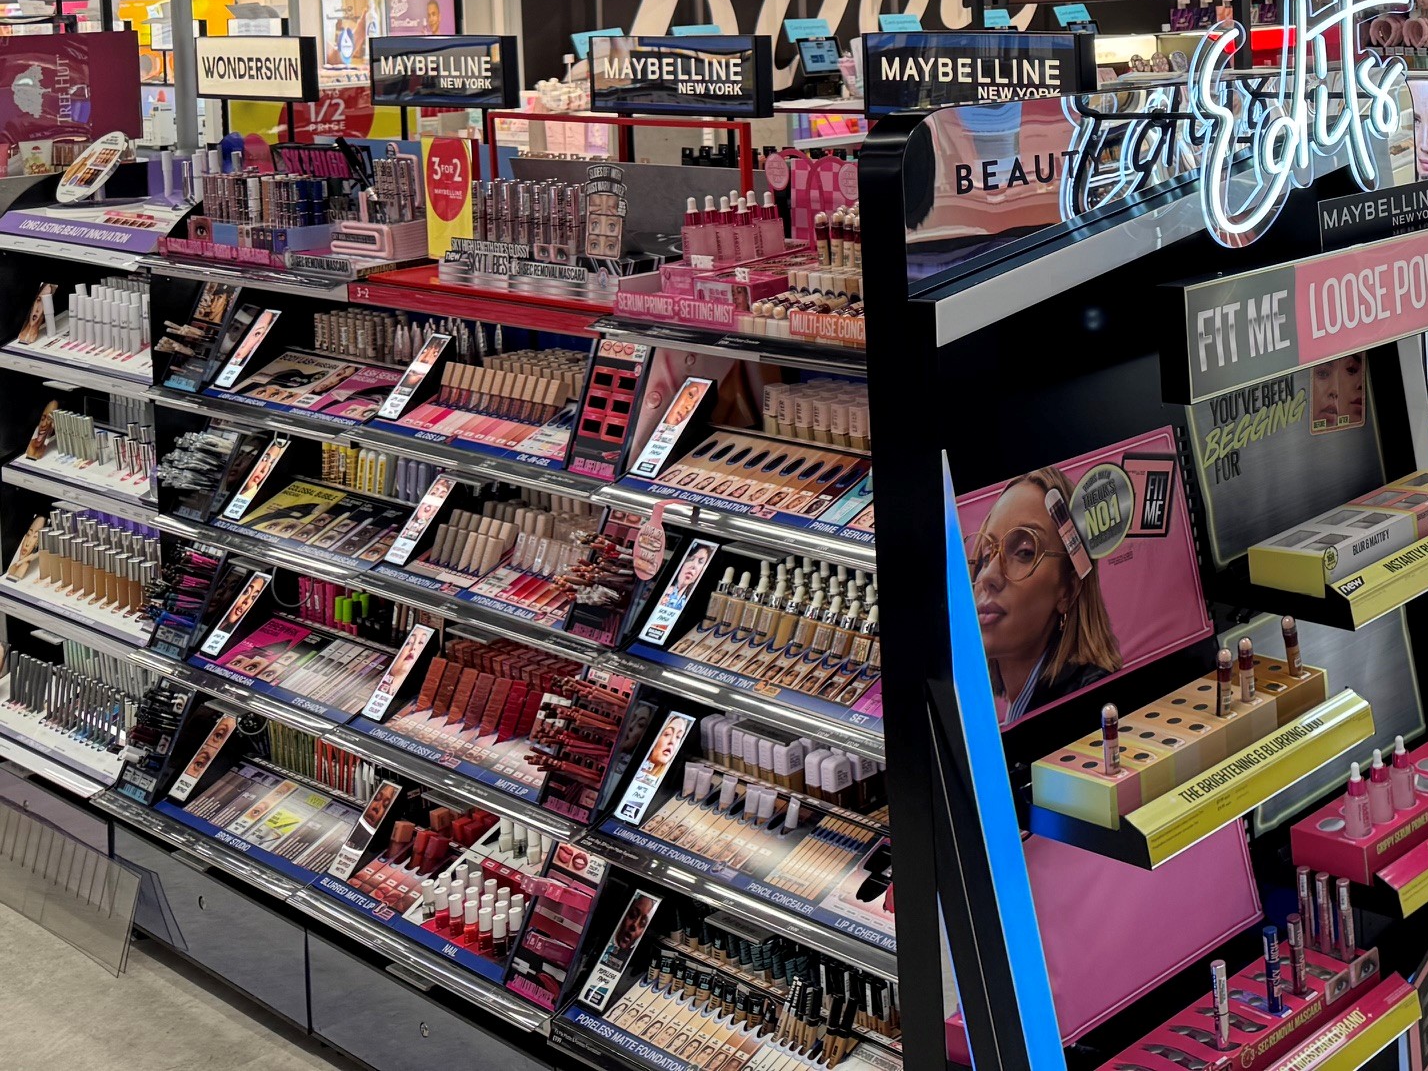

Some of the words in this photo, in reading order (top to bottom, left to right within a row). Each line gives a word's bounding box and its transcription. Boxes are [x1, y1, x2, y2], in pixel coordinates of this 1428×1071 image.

[55, 56, 70, 80] HUT
[202, 56, 299, 81] WONDERSKIN
[380, 55, 492, 77] MAYBELLINE
[603, 57, 743, 81] MAYBELLINE
[881, 57, 1061, 85] MAYBELLINE
[440, 78, 462, 89] NEW
[464, 78, 492, 89] YORK
[678, 82, 707, 95] NEW
[708, 82, 743, 96] YORK
[978, 86, 1013, 100] NEW
[1016, 87, 1061, 99] YORK
[57, 81, 71, 125] TREE
[310, 100, 346, 121] 1/2
[281, 148, 312, 175] SKY
[314, 151, 349, 178] HIGH
[432, 157, 442, 181] 3
[442, 165, 454, 173] FOR
[453, 158, 462, 182] 2
[19, 219, 38, 231] LONG
[38, 221, 65, 236] LASTING
[63, 225, 89, 240] BEAUTY
[86, 229, 132, 243] INNOVATION
[1392, 211, 1416, 226] NEW
[446, 252, 462, 262] new
[618, 293, 645, 313] SERUM
[644, 295, 674, 317] PRIMER
[680, 299, 714, 321] SETTING
[713, 302, 734, 324] MIST
[1198, 301, 1240, 373] FIT
[1248, 289, 1290, 358] ME
[1309, 263, 1392, 340] LOOSE
[792, 313, 837, 335] MULTI-USE
[838, 315, 865, 338] CONC
[1210, 384, 1260, 427] YOU'VE
[1258, 375, 1296, 409] BEEN
[1204, 389, 1307, 469] BEGGING
[1338, 415, 1349, 425] AFTER
[415, 431, 432, 441] GLOSS
[1215, 453, 1241, 485] FOR
[647, 484, 674, 499] PLUMP
[679, 490, 703, 506] GLOW
[700, 495, 750, 514] FOUNDATION
[1147, 475, 1167, 500] FIT
[1084, 494, 1120, 540] NO.1
[1144, 501, 1164, 526] ME
[811, 521, 838, 535] PRIME
[840, 525, 872, 543] SERUM
[1352, 541, 1366, 556] BLUR
[1370, 529, 1390, 549] MATTIFY
[1382, 545, 1427, 573] INSTANTLY
[1341, 577, 1363, 595] new
[470, 595, 504, 611] HYDRATING
[503, 603, 514, 614] OIL
[514, 607, 536, 620] BALM
[684, 661, 716, 680] RADIANT
[716, 671, 736, 685] SKIN
[734, 677, 754, 691] TINT
[304, 701, 328, 715] SHADOW
[850, 713, 868, 725] SET
[369, 728, 384, 739] LONG
[384, 732, 408, 749] LASTING
[408, 741, 431, 758] GLOSSY
[1178, 787, 1204, 804] THE
[1199, 753, 1261, 793] BRIGHTENING
[1260, 725, 1307, 757] BLURRING
[494, 778, 514, 792] MATTE
[514, 785, 528, 796] LIP
[214, 831, 233, 844] BROW
[229, 838, 252, 852] STUDIO
[612, 827, 642, 845] LUMINOUS
[641, 838, 666, 856] MATTE
[666, 847, 710, 871] FOUNDATION
[320, 877, 347, 896] BLURRED
[346, 890, 366, 907] MATTE
[746, 883, 770, 897] PENCIL
[770, 891, 814, 915] CONCEALER
[834, 919, 848, 929] LIP
[854, 926, 880, 943] CHEEK
[442, 943, 458, 957] NAIL
[576, 1013, 615, 1038] PORELESS
[612, 1033, 639, 1051] MATTE
[634, 1044, 686, 1071] FOUNDATION
